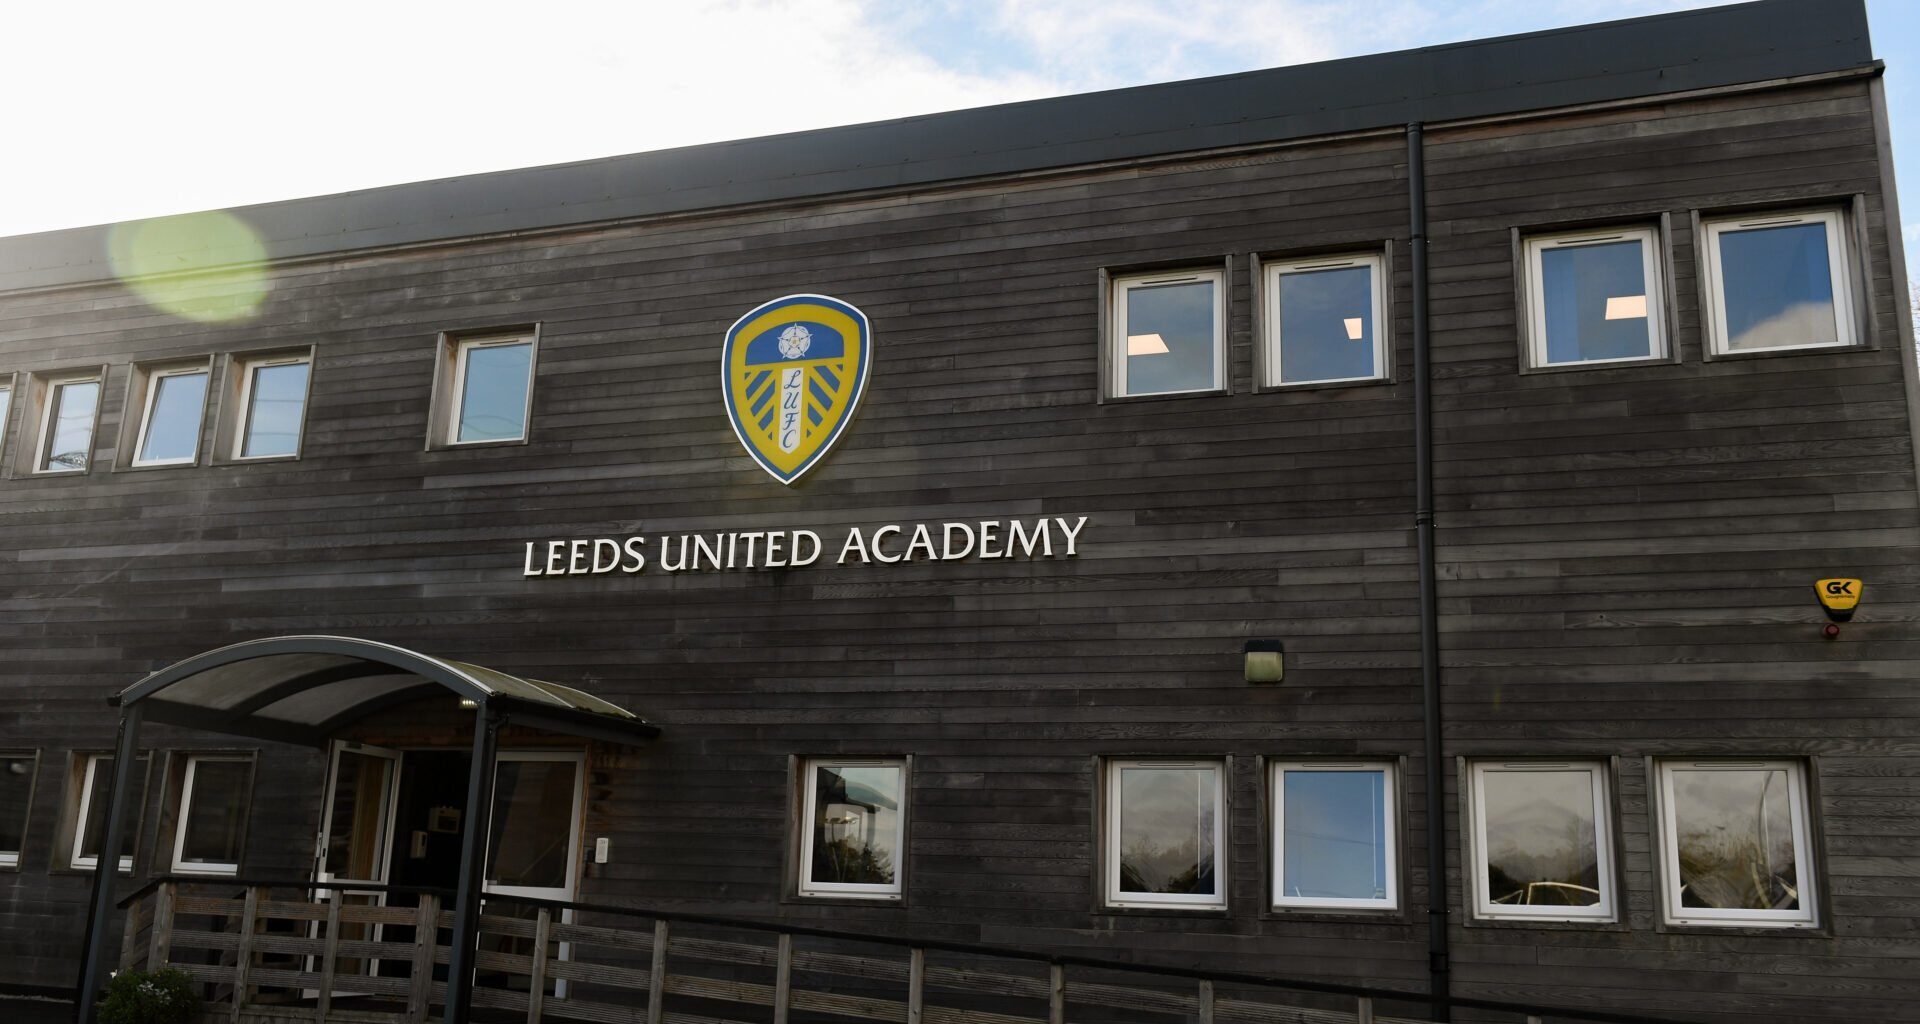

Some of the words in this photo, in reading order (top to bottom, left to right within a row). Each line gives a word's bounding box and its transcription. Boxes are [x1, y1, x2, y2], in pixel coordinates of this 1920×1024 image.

[783, 369, 801, 449] LUFC
[523, 536, 645, 576] LEEDS
[660, 529, 822, 571] UNITED
[836, 516, 1089, 564] ACADEMY
[1826, 581, 1852, 594] GK
